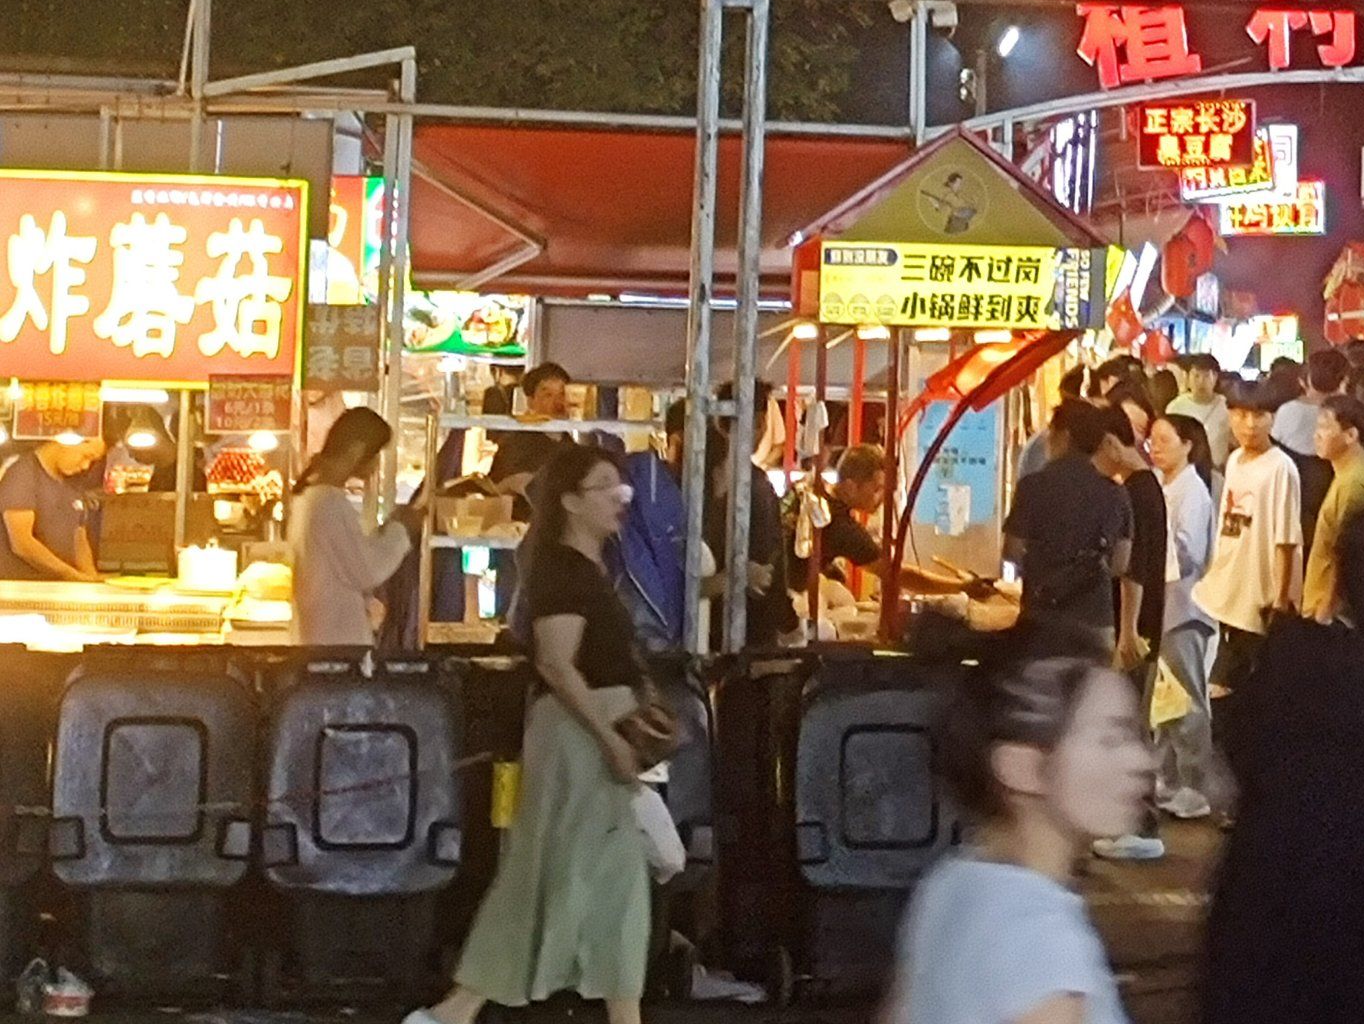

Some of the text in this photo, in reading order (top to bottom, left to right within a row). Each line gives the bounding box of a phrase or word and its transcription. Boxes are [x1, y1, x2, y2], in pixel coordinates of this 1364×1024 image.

[1143, 101, 1247, 134] 正宗长沙
[0, 210, 293, 359] 炸蘑菇
[900, 253, 1042, 285] 三碗不过岗
[900, 292, 1042, 324] 小锅鲜到爽
